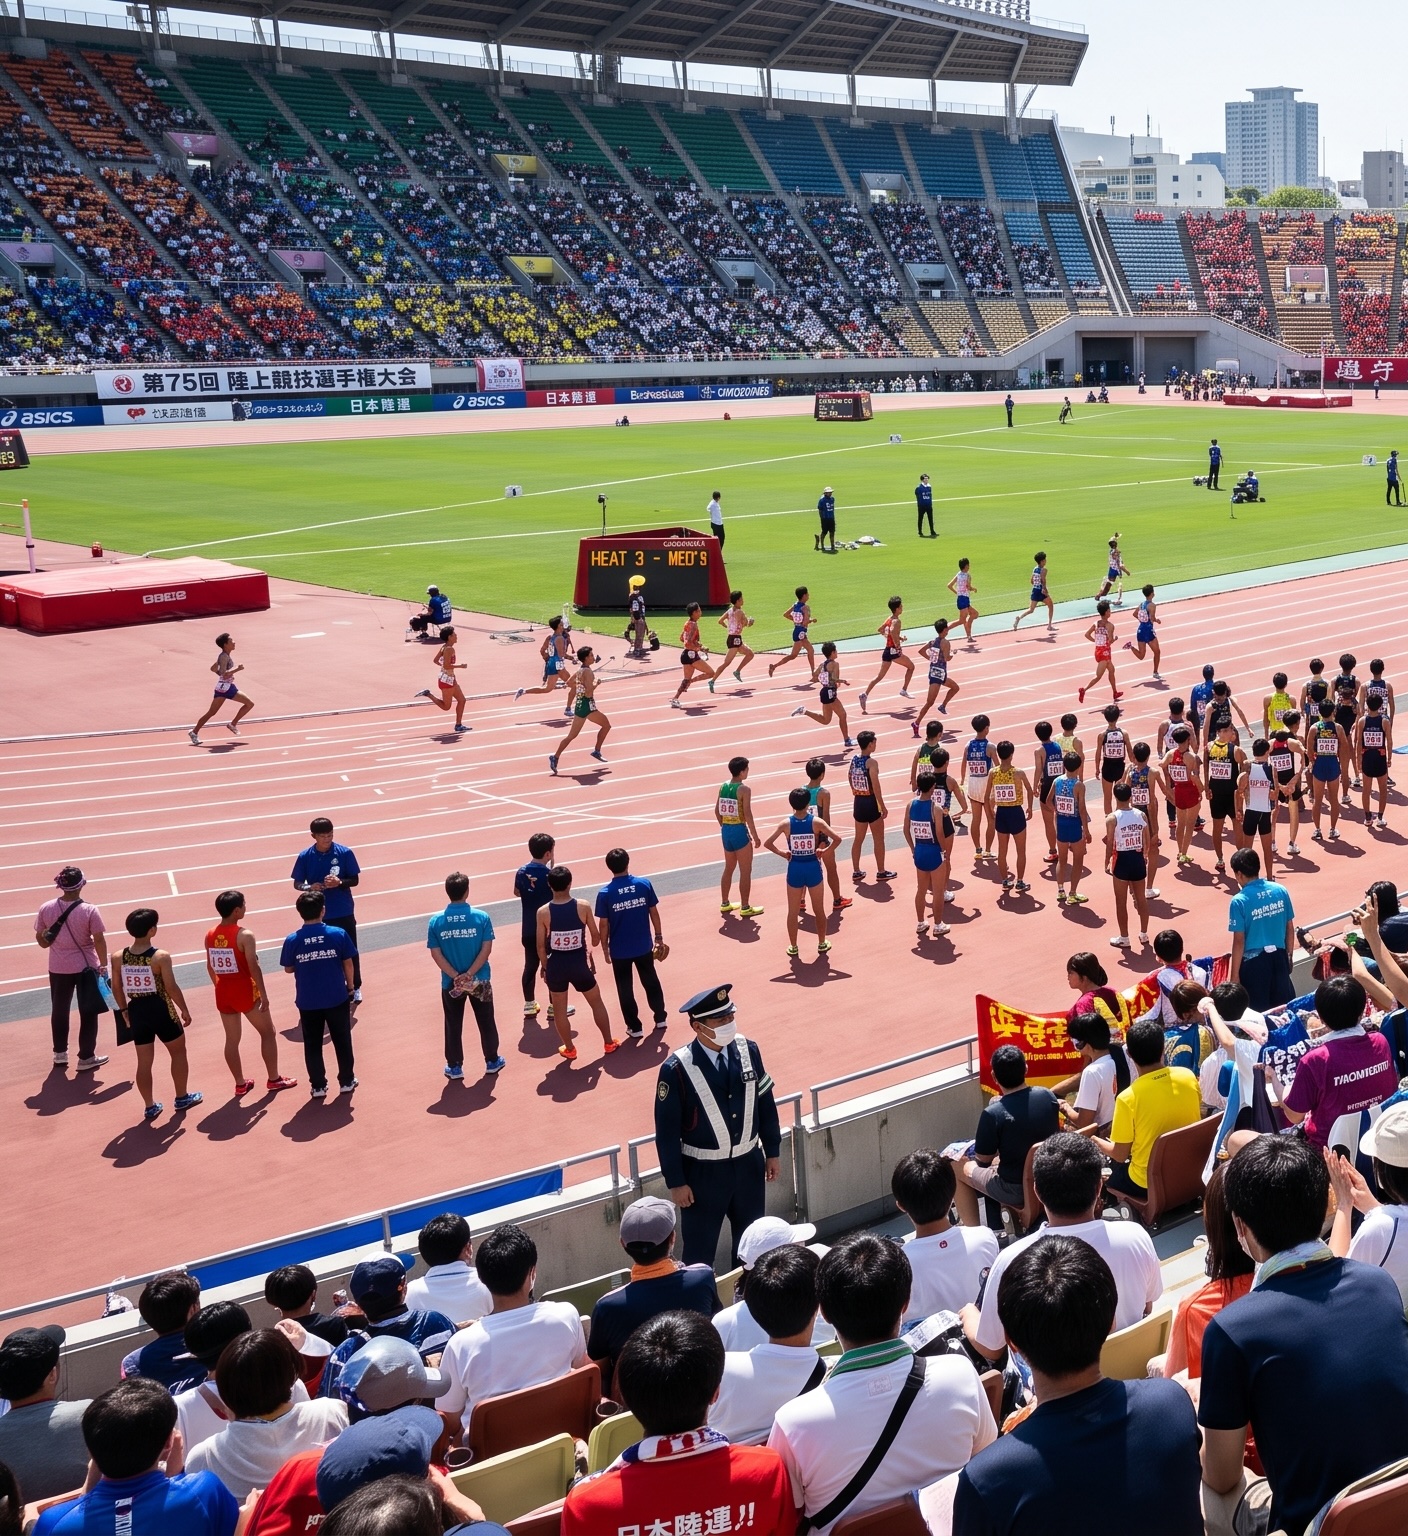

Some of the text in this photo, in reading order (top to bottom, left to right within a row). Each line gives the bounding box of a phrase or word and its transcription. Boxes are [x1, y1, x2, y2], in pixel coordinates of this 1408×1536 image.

[142, 367, 416, 393] 第75回 陸上競技選手権大会
[591, 550, 627, 566] HEAT
[635, 551, 644, 566] 3
